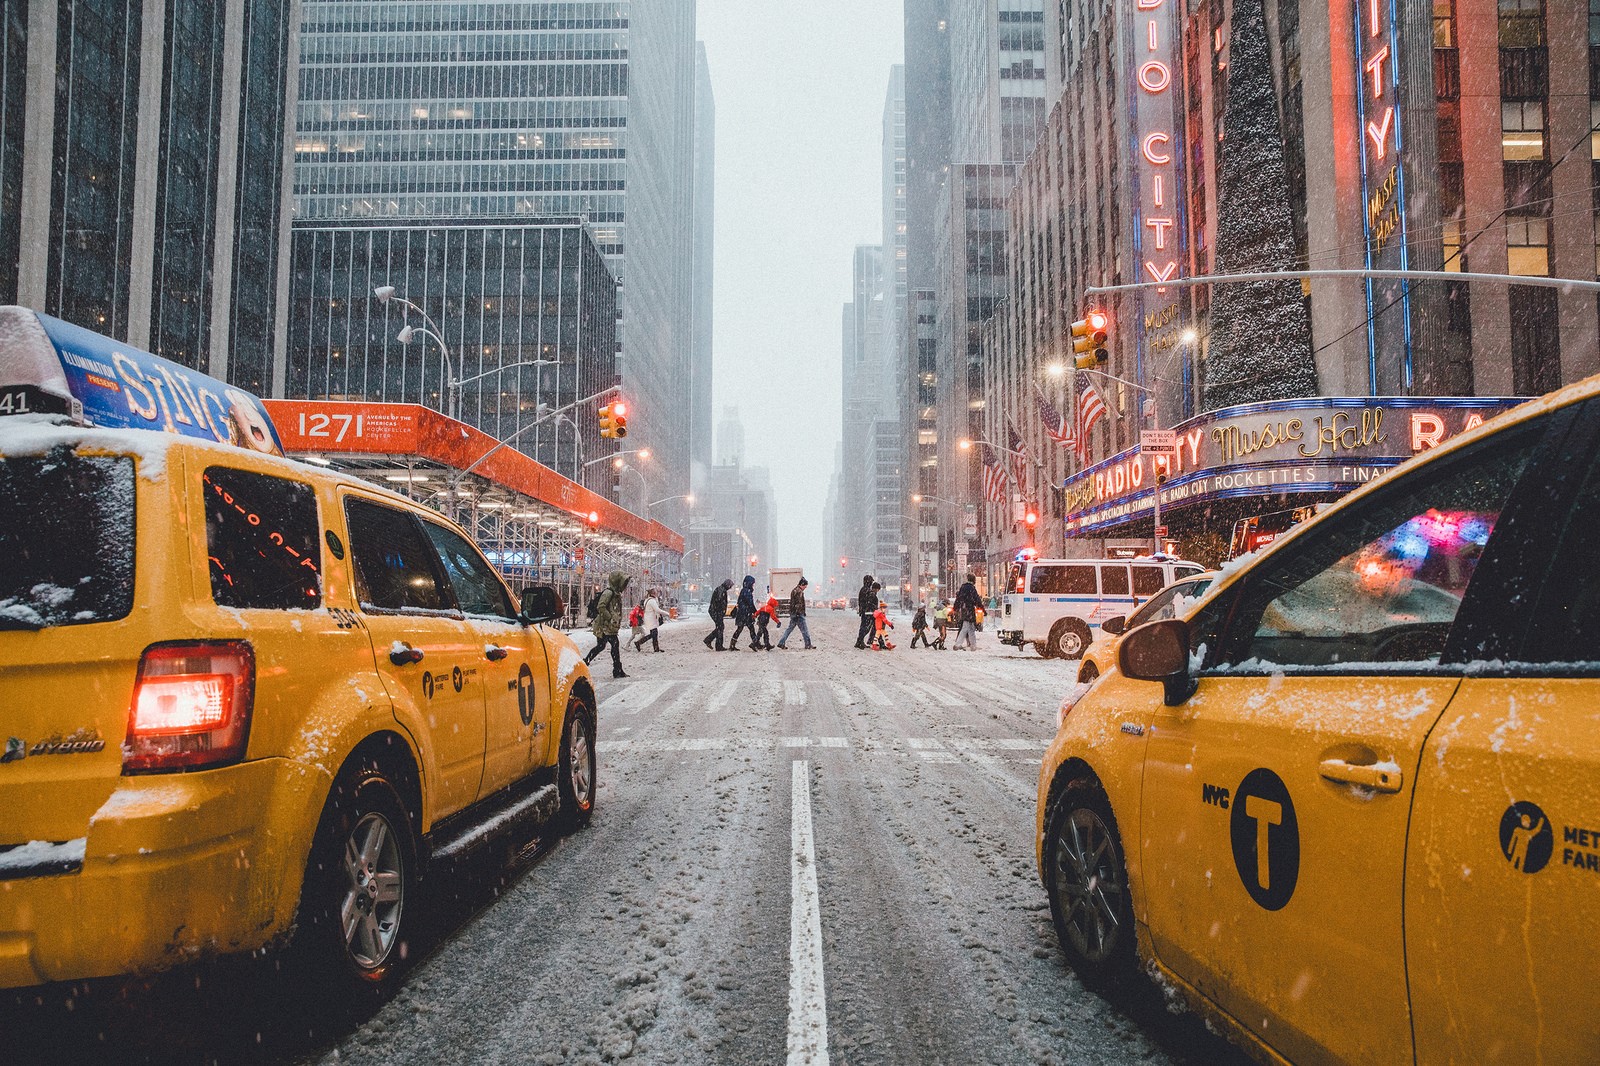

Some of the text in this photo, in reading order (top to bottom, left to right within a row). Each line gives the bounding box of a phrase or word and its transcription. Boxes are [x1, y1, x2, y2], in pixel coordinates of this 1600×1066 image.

[1138, 0, 1178, 292] IO CITY
[61, 350, 117, 379] ILLUMINATION
[87, 374, 119, 391] PRESENTS
[0, 391, 30, 414] 41
[299, 412, 363, 443] 1271
[1095, 454, 1143, 501] RADIO
[1210, 418, 1304, 463] Music
[1298, 407, 1388, 458] Hall
[1170, 485, 1189, 501] RADIO
[1191, 477, 1208, 494] CITY
[1215, 468, 1316, 489] ROCKETTES
[508, 675, 531, 717] NYC T
[1202, 783, 1283, 890] NYC T
